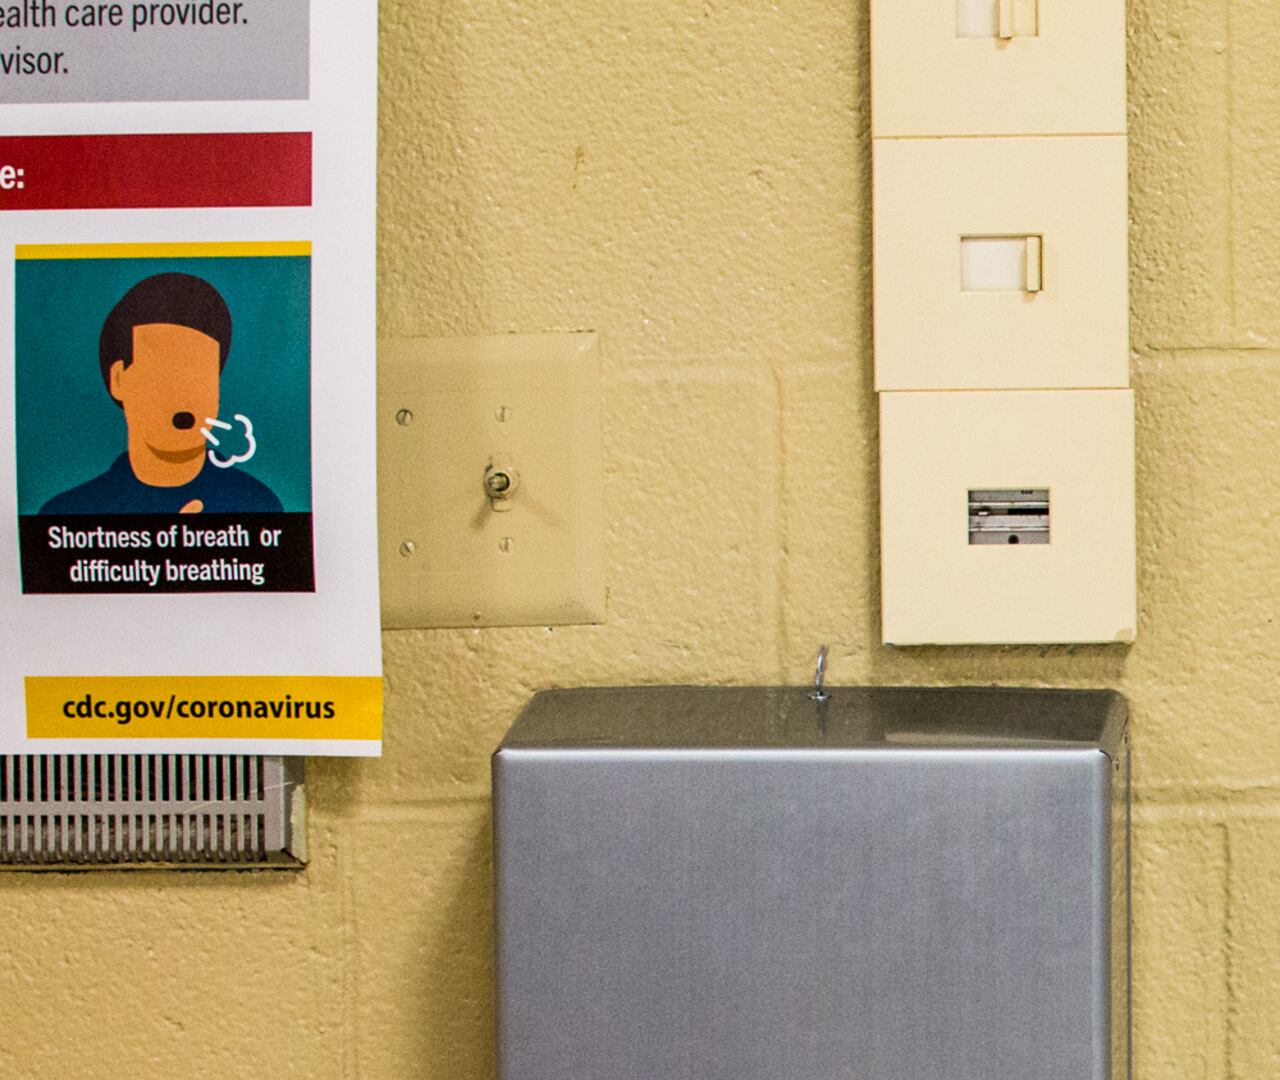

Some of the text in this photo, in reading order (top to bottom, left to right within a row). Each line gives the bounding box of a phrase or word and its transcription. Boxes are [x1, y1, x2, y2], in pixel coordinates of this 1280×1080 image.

[65, 4, 123, 27] care
[133, 0, 248, 32] provider.
[0, 45, 68, 75] visor.
[48, 525, 282, 549] Shortness of breath or
[70, 558, 265, 586] difficulty breathing
[63, 694, 335, 724] cdc.gov/coronavirus
